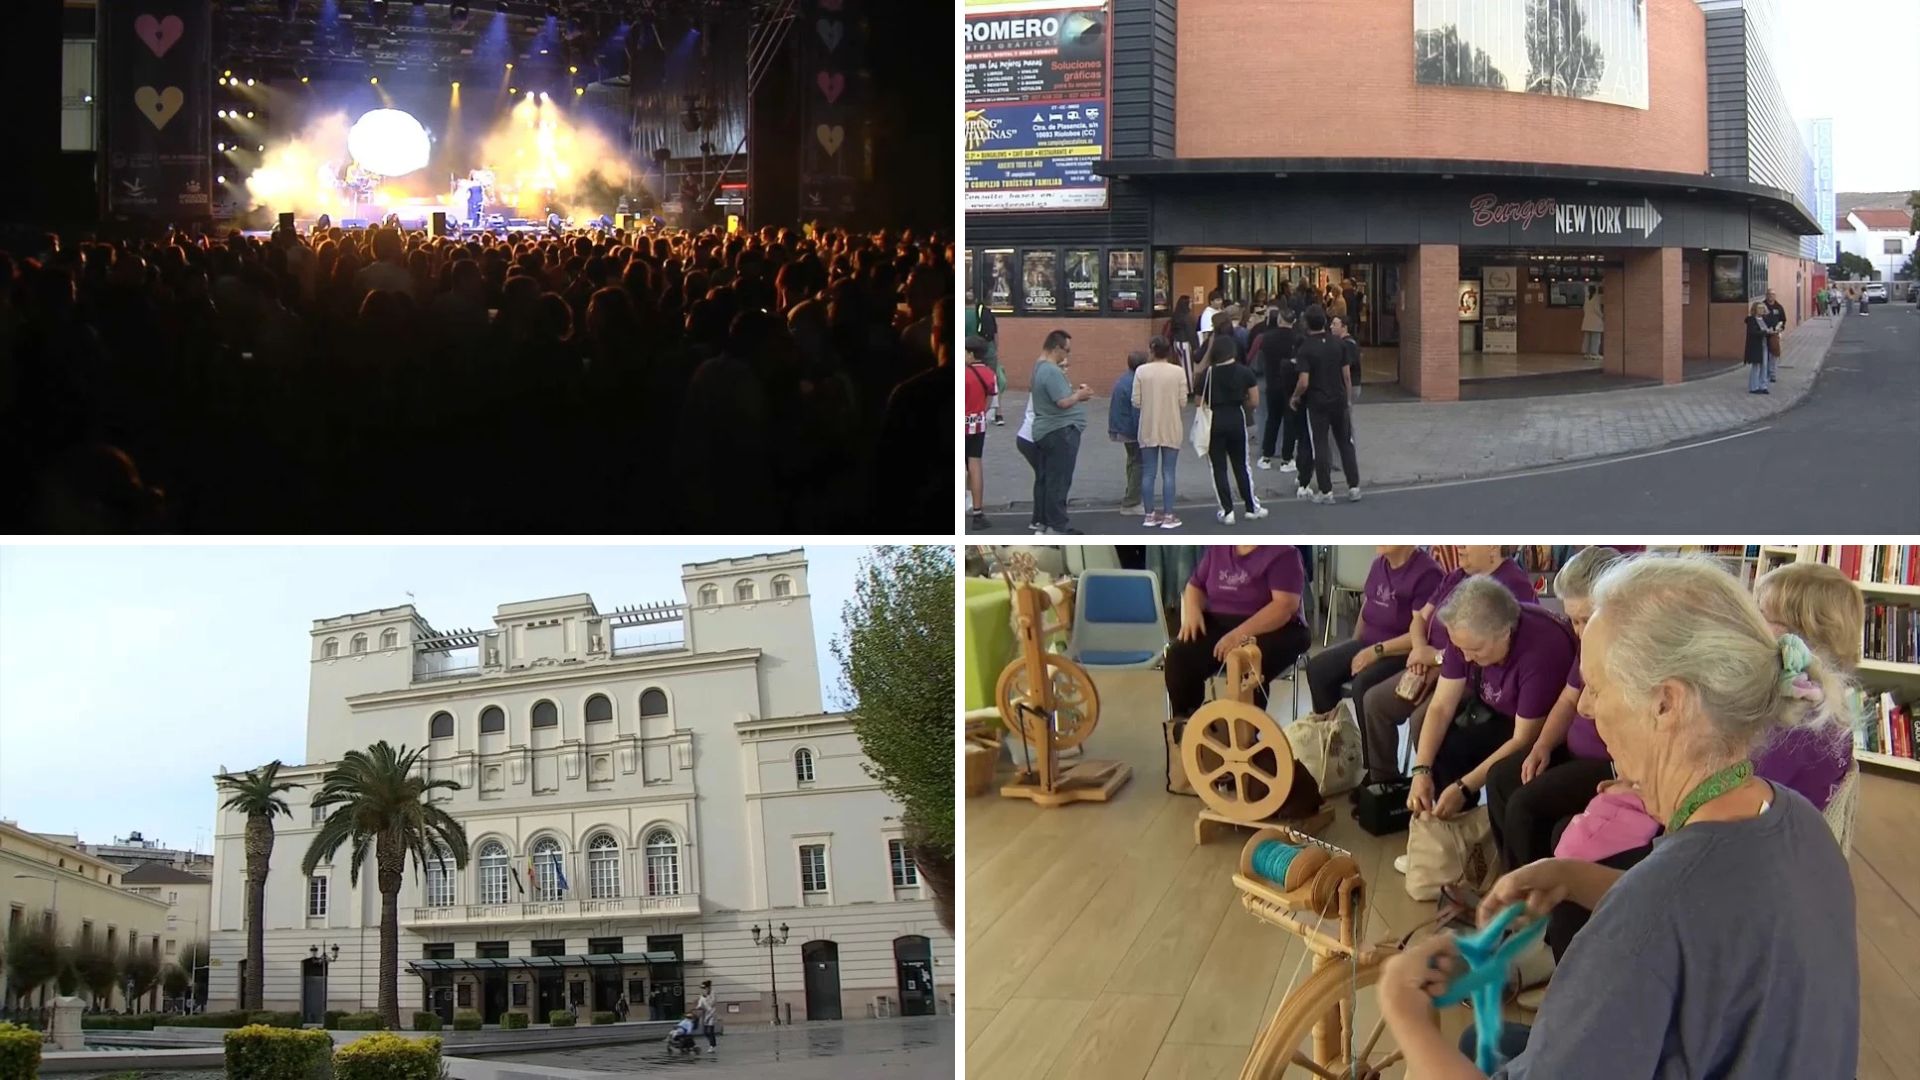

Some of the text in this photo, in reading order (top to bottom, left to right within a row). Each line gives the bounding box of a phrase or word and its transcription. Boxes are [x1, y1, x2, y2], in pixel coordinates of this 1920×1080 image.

[965, 17, 1059, 42] ROMERO
[1051, 60, 1102, 71] Soluciones
[1470, 193, 1622, 235] Burger NEW YORK
